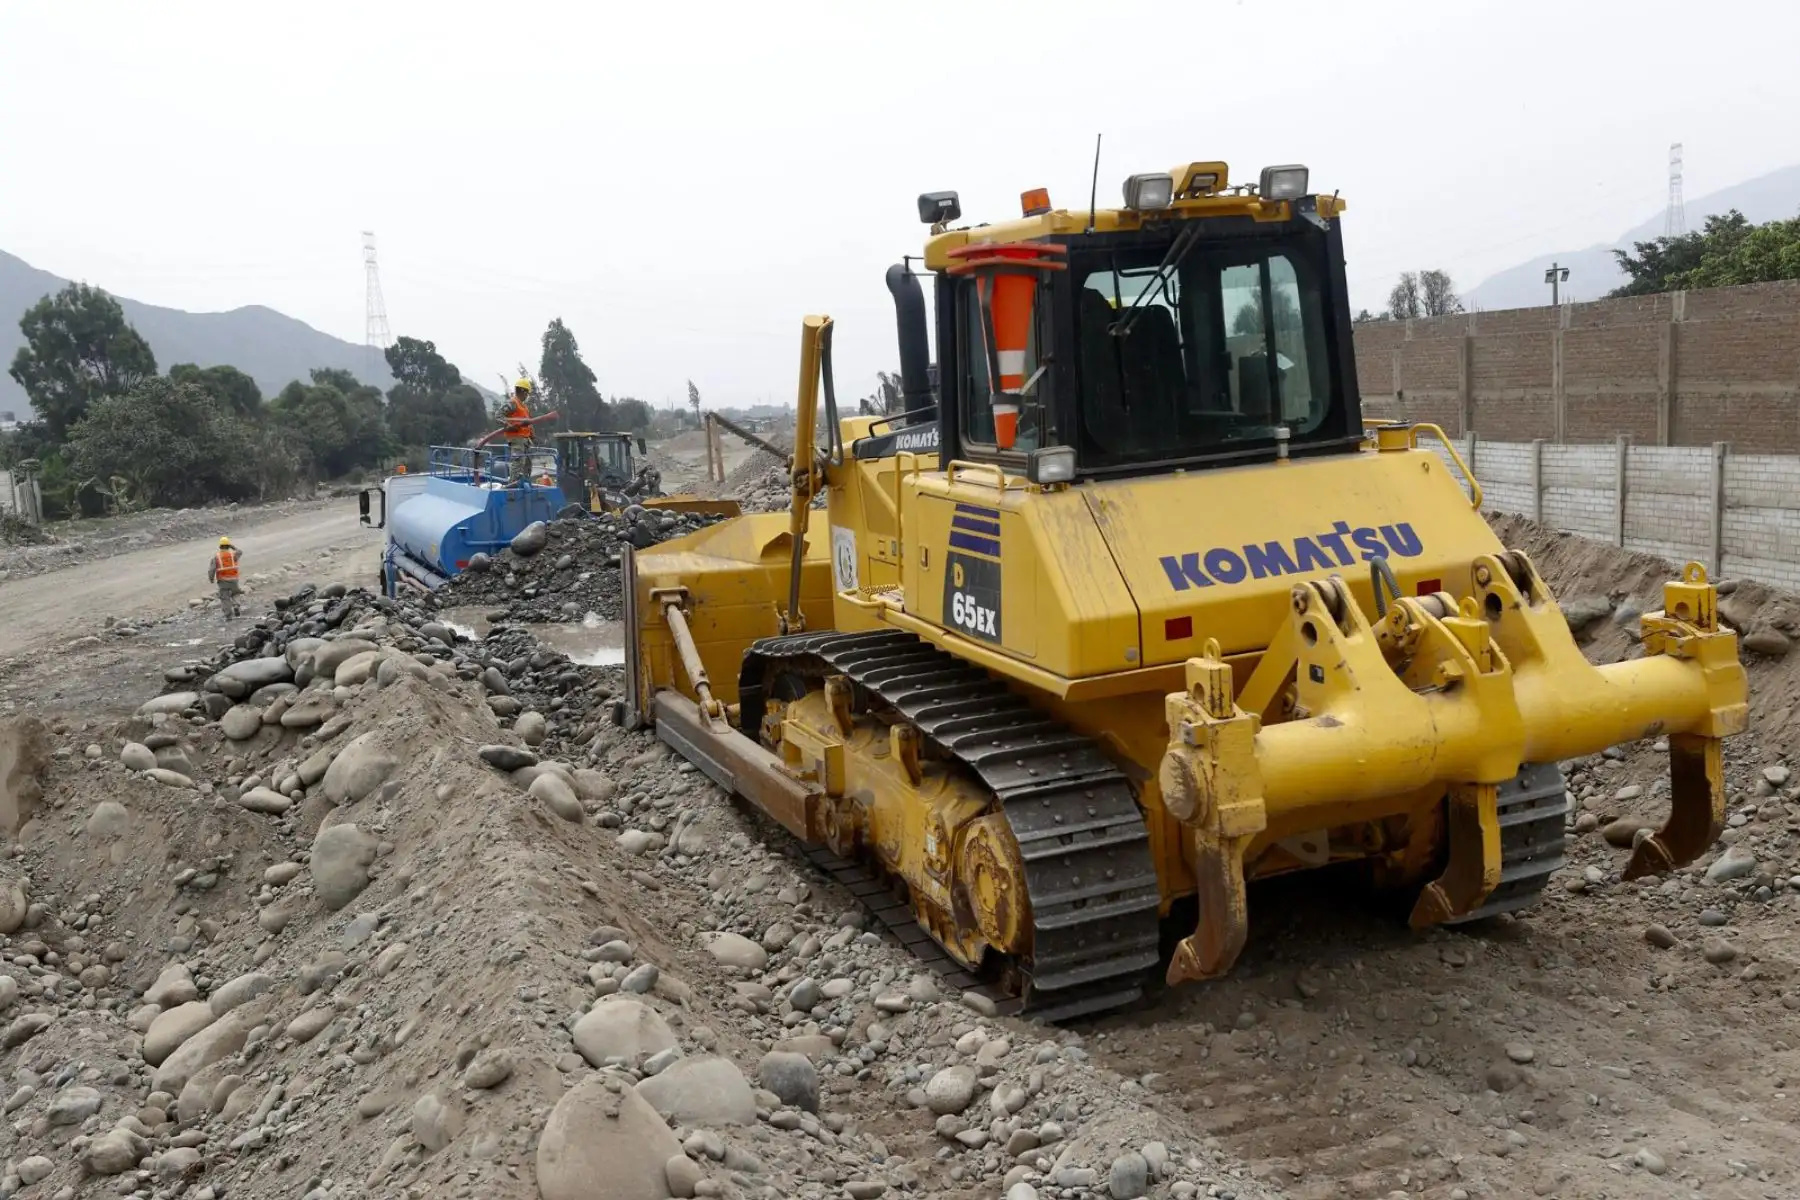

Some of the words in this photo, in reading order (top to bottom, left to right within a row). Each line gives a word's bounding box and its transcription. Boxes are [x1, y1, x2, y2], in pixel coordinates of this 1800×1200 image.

[953, 562, 964, 588] D
[1159, 521, 1424, 591] KOMATSU
[953, 591, 996, 636] 65EX
